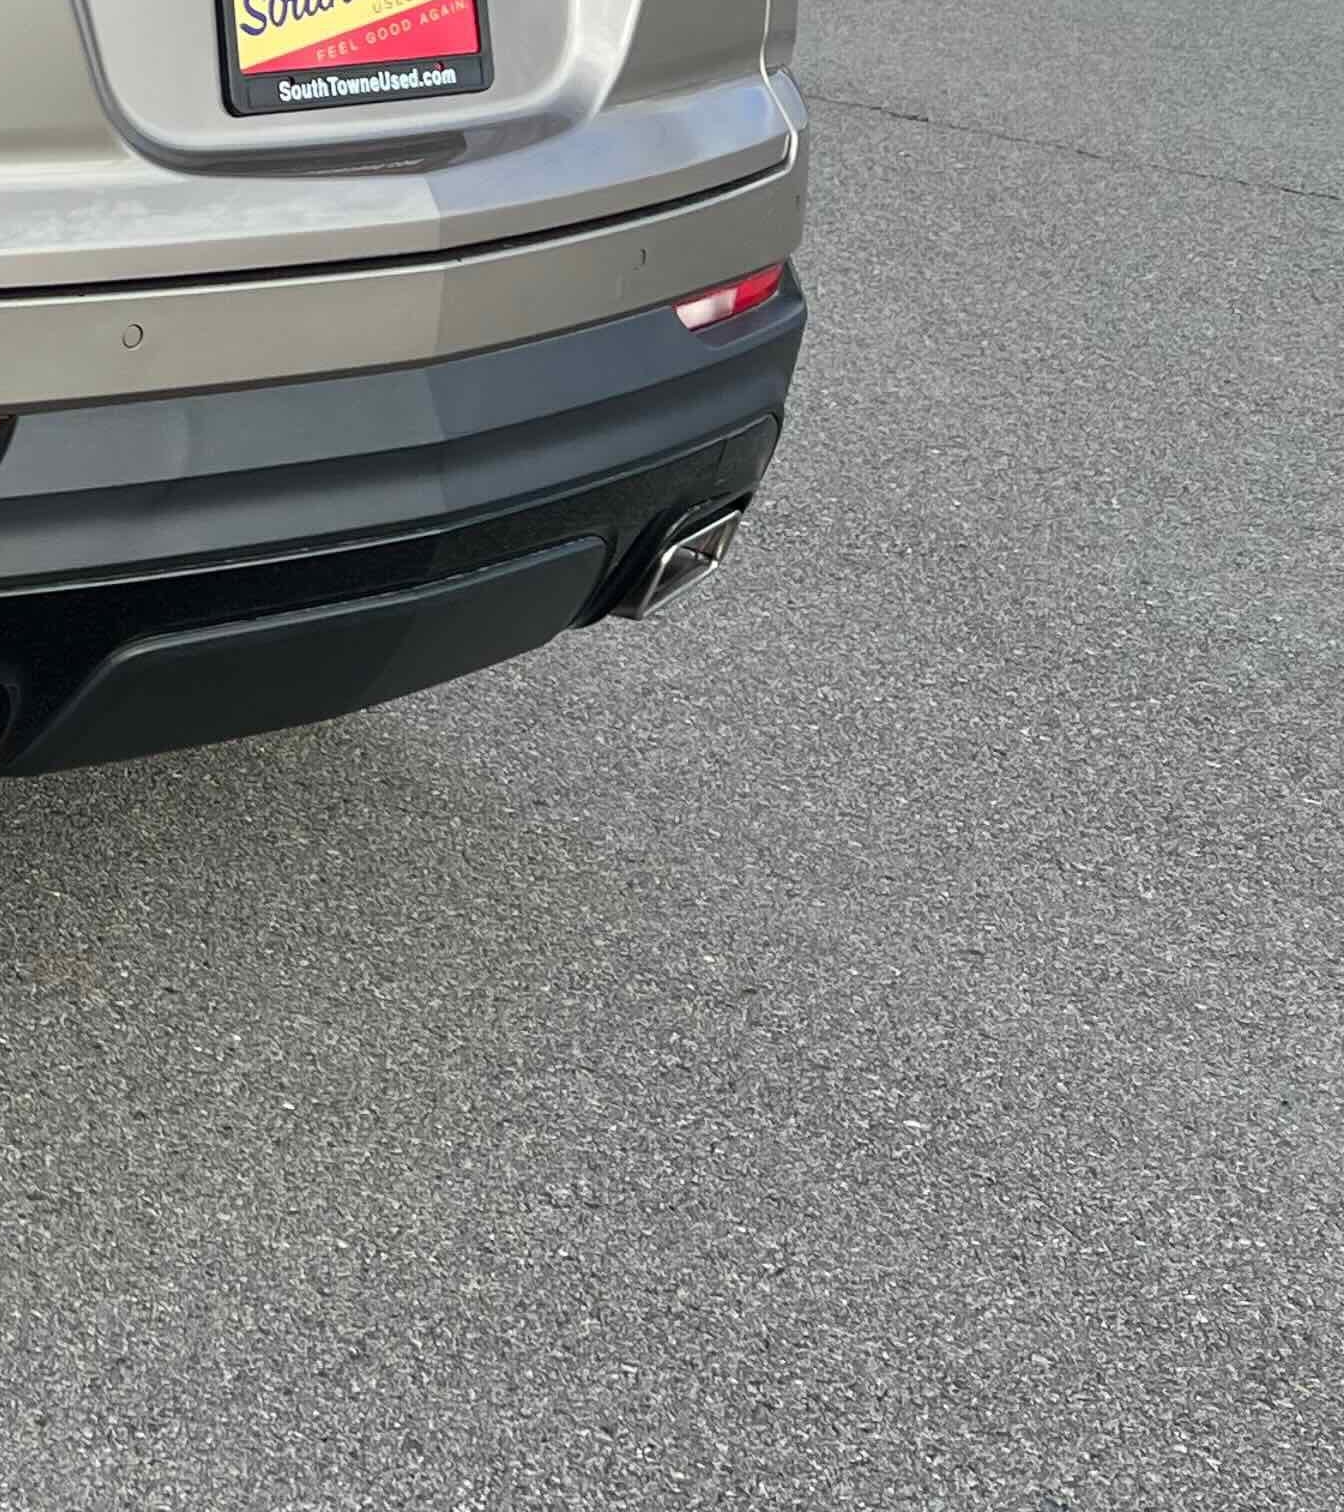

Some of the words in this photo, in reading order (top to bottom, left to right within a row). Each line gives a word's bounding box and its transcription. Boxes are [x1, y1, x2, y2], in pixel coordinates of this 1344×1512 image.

[316, 40, 359, 62] FEEL
[365, 18, 412, 45] GOOD
[279, 68, 457, 102] SouthTowneUsed.com
